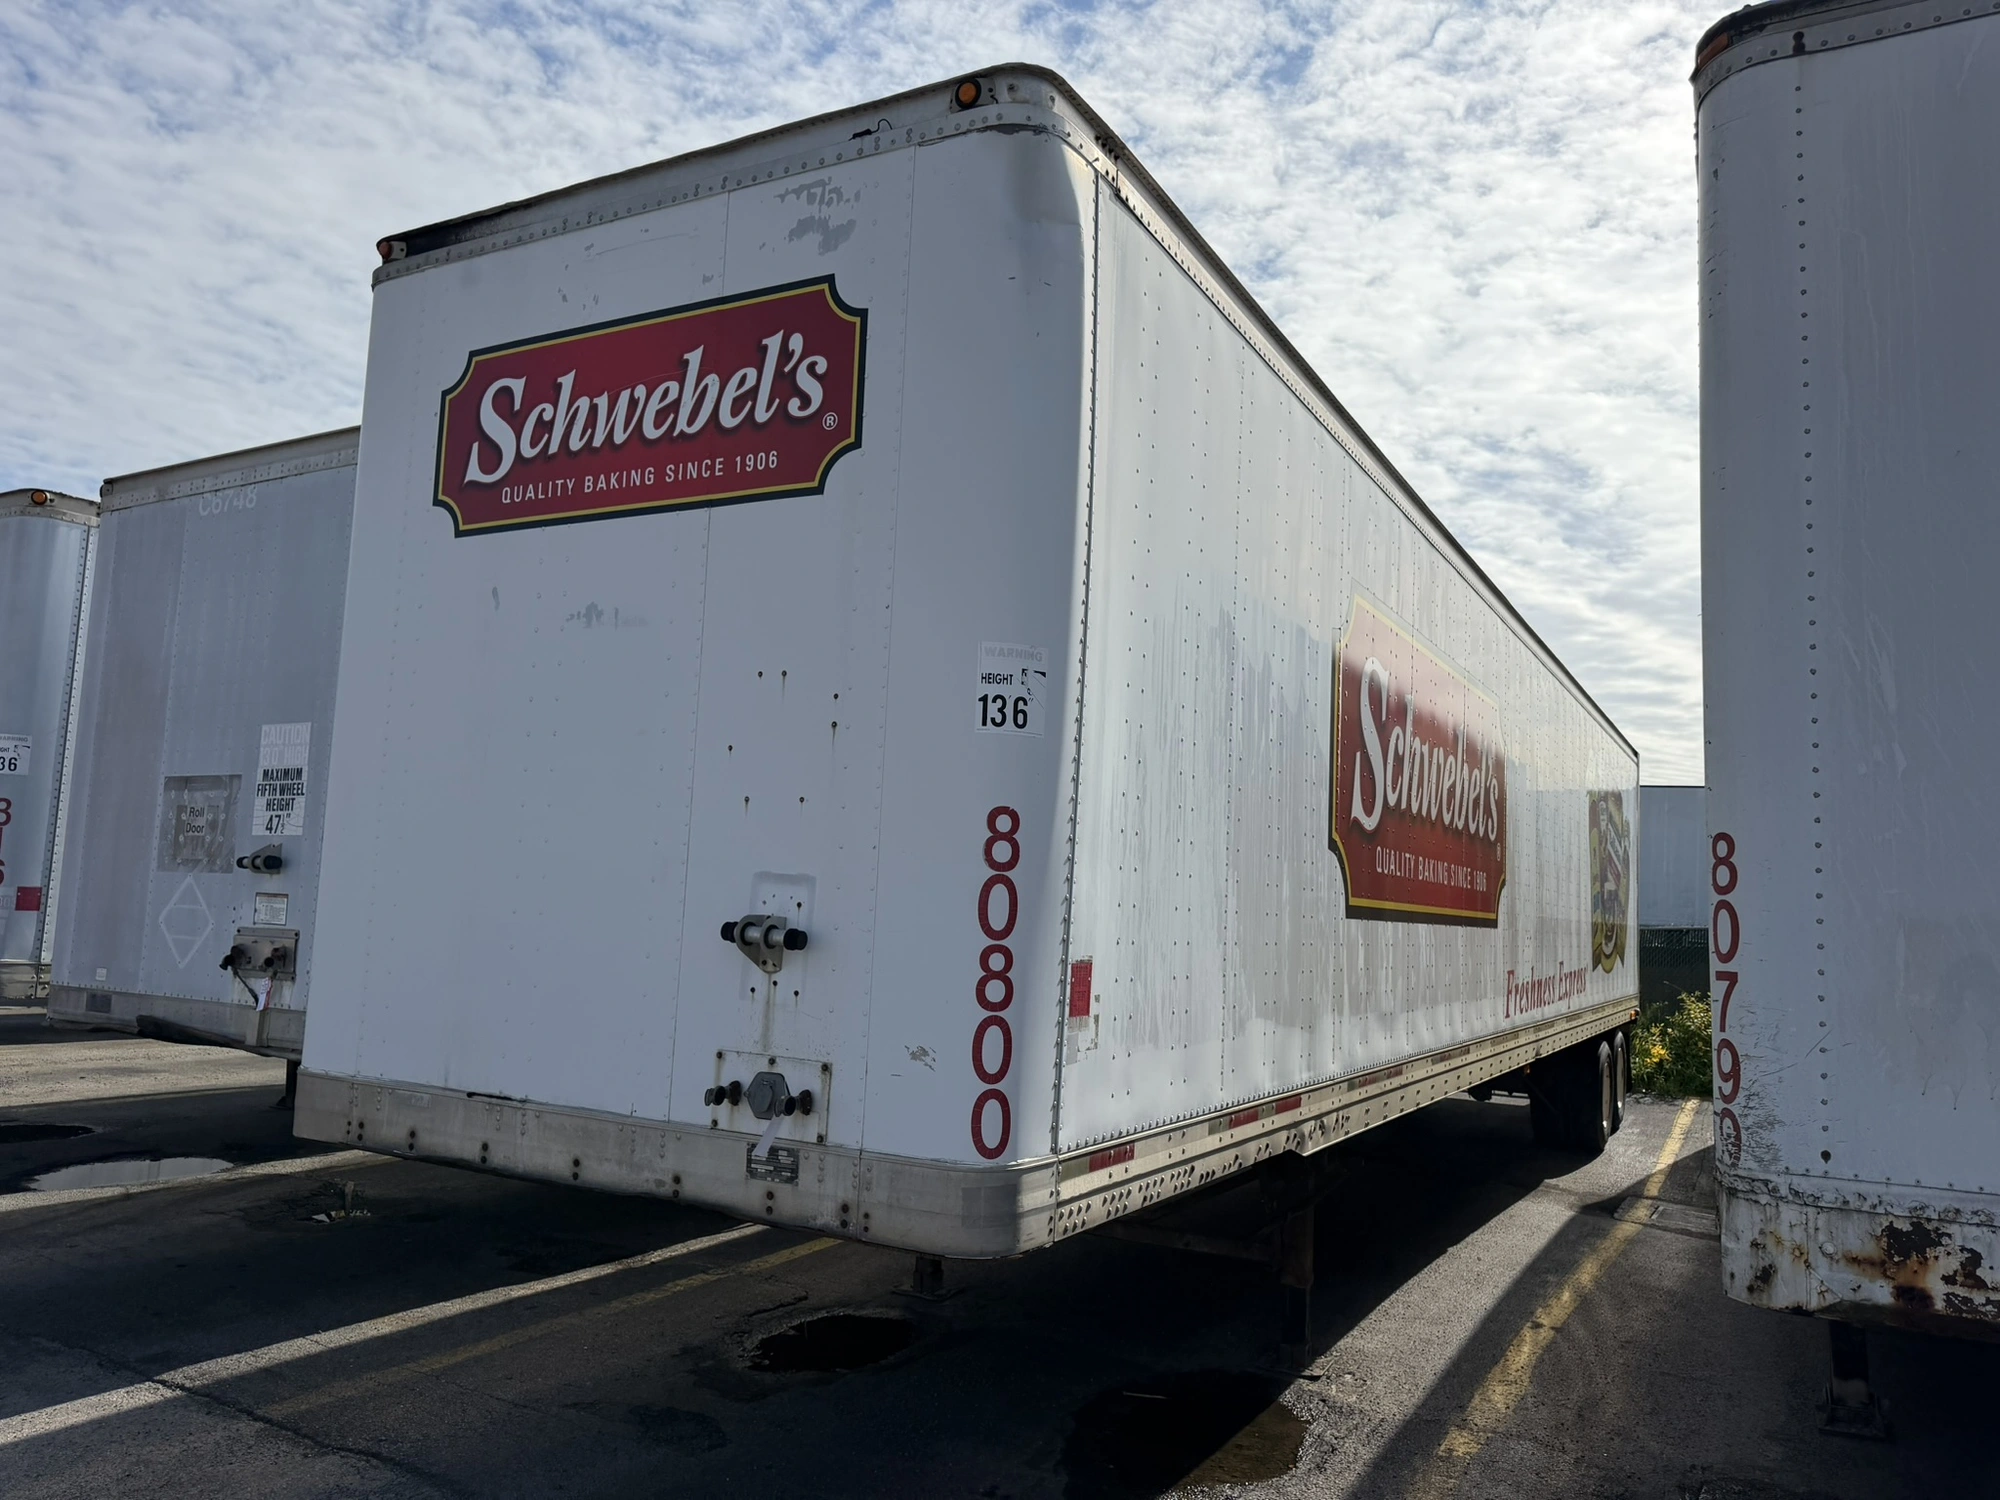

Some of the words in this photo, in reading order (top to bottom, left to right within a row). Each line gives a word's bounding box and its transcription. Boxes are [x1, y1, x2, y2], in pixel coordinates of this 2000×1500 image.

[464, 330, 827, 487] Schwebel's
[501, 478, 576, 504] QUALITY
[584, 467, 655, 493] BAKING
[665, 458, 724, 482] SINCE
[735, 450, 778, 473] 1906
[984, 646, 1043, 662] WARNING
[980, 672, 1014, 686] HEIGHT
[261, 725, 310, 745] CAUTION
[1350, 656, 1499, 842] Schwebel's
[262, 767, 303, 782] MAXIMUM
[256, 783, 277, 797] FIFTH
[279, 782, 305, 796] WHEEL
[189, 807, 205, 818] Roll
[265, 798, 296, 812] HEIGHT
[186, 822, 205, 833] Door
[1376, 846, 1415, 879] QUALITY
[1418, 856, 1448, 885] BAKING
[1450, 863, 1471, 889] SINCE
[1473, 870, 1487, 892] 1906
[971, 805, 1020, 1160] 80800
[1505, 965, 1556, 1019] Freshness
[1558, 960, 1587, 1010] Express
[1711, 832, 1742, 1168] 80799
